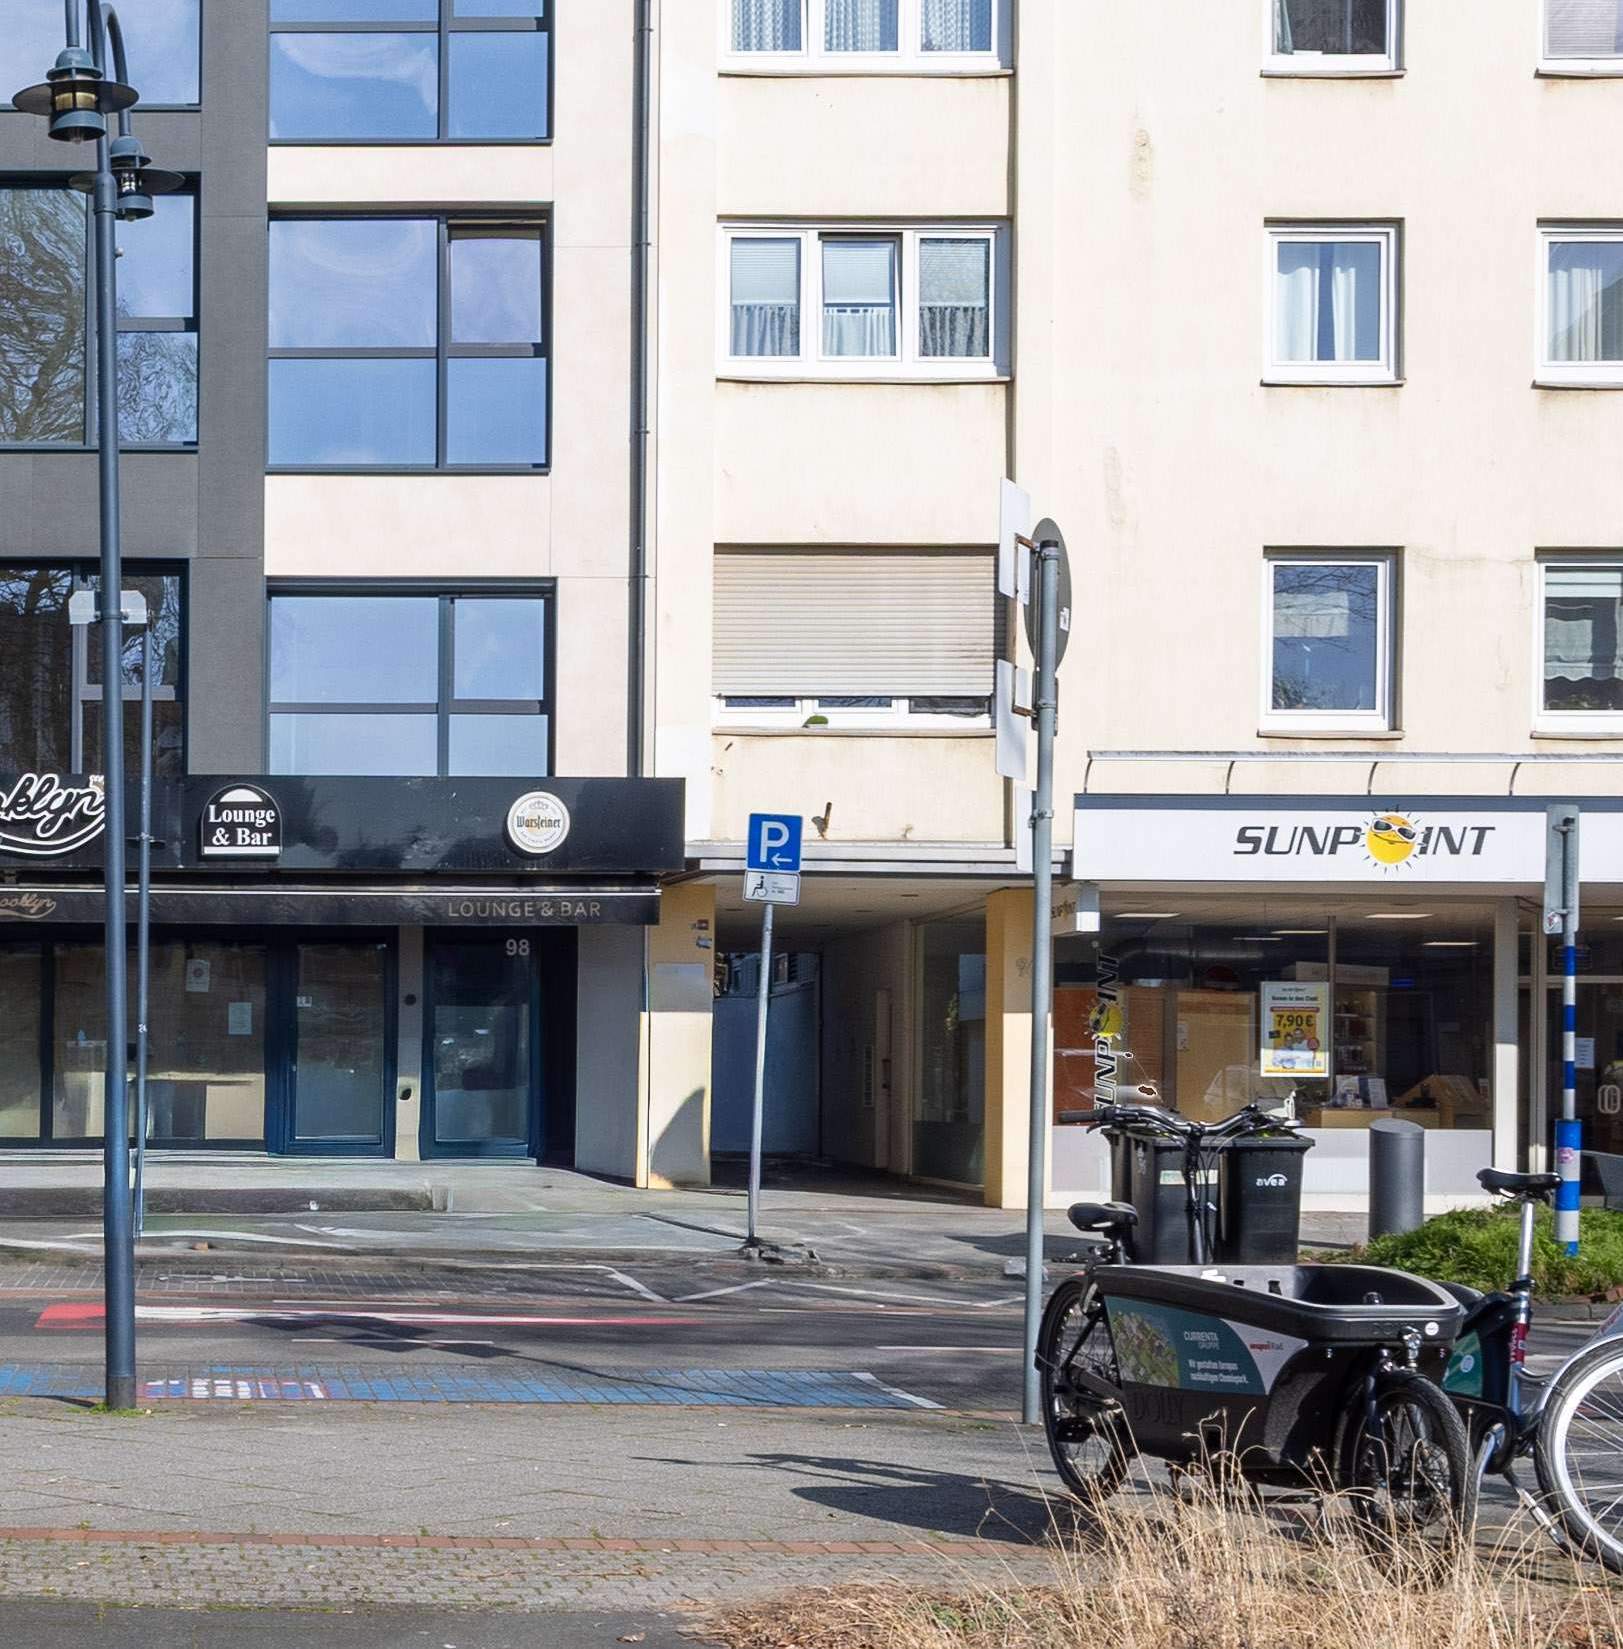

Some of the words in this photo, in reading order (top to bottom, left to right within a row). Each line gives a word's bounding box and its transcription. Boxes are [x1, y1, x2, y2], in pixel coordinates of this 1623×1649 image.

[208, 804, 276, 827] Lounge
[211, 828, 230, 846] &
[237, 827, 272, 846] Bar
[760, 821, 790, 863] P
[448, 901, 534, 918] LOUNGE
[540, 902, 553, 917] &
[560, 902, 601, 918] BAR
[505, 939, 530, 956] 98
[1255, 1176, 1286, 1187] avea
